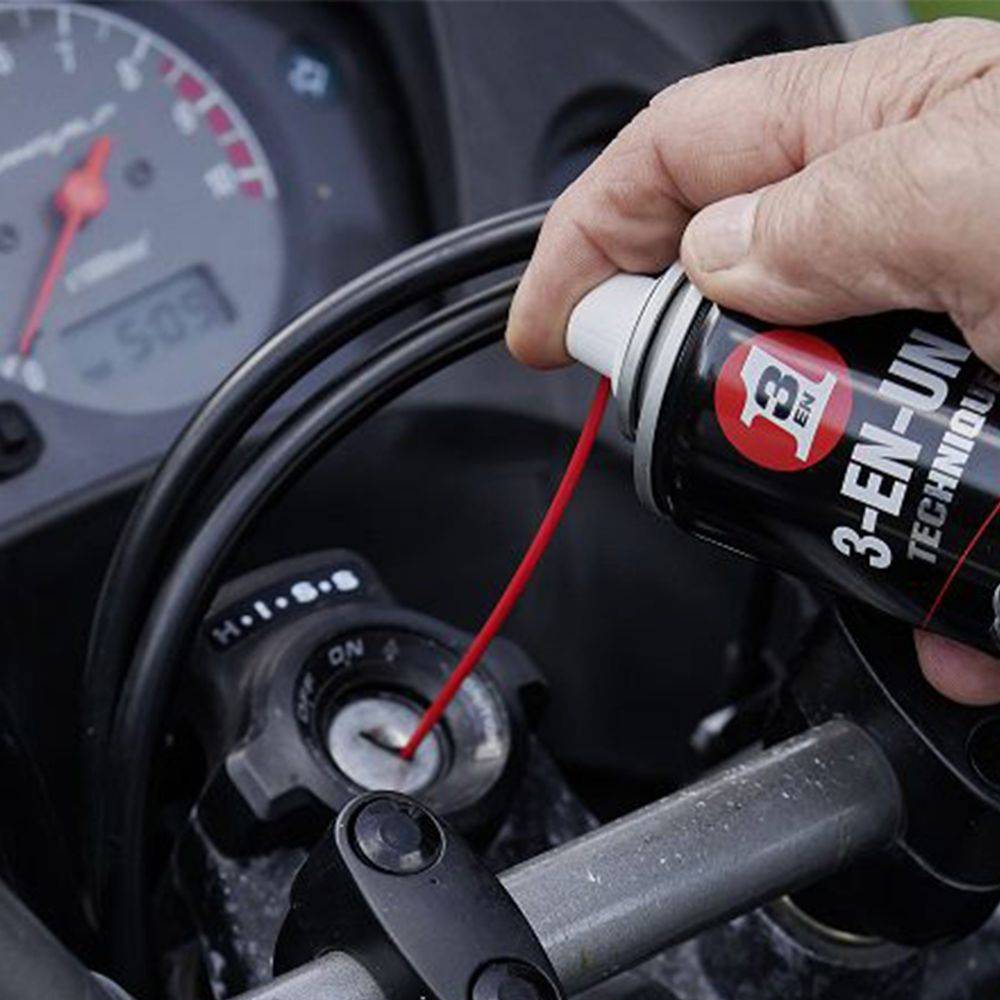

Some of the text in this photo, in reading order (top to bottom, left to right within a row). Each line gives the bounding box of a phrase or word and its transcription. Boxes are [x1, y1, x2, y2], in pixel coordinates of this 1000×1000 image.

[793, 392, 816, 428] EN
[831, 328, 972, 569] 3-EN-UN
[328, 638, 364, 667] ON
